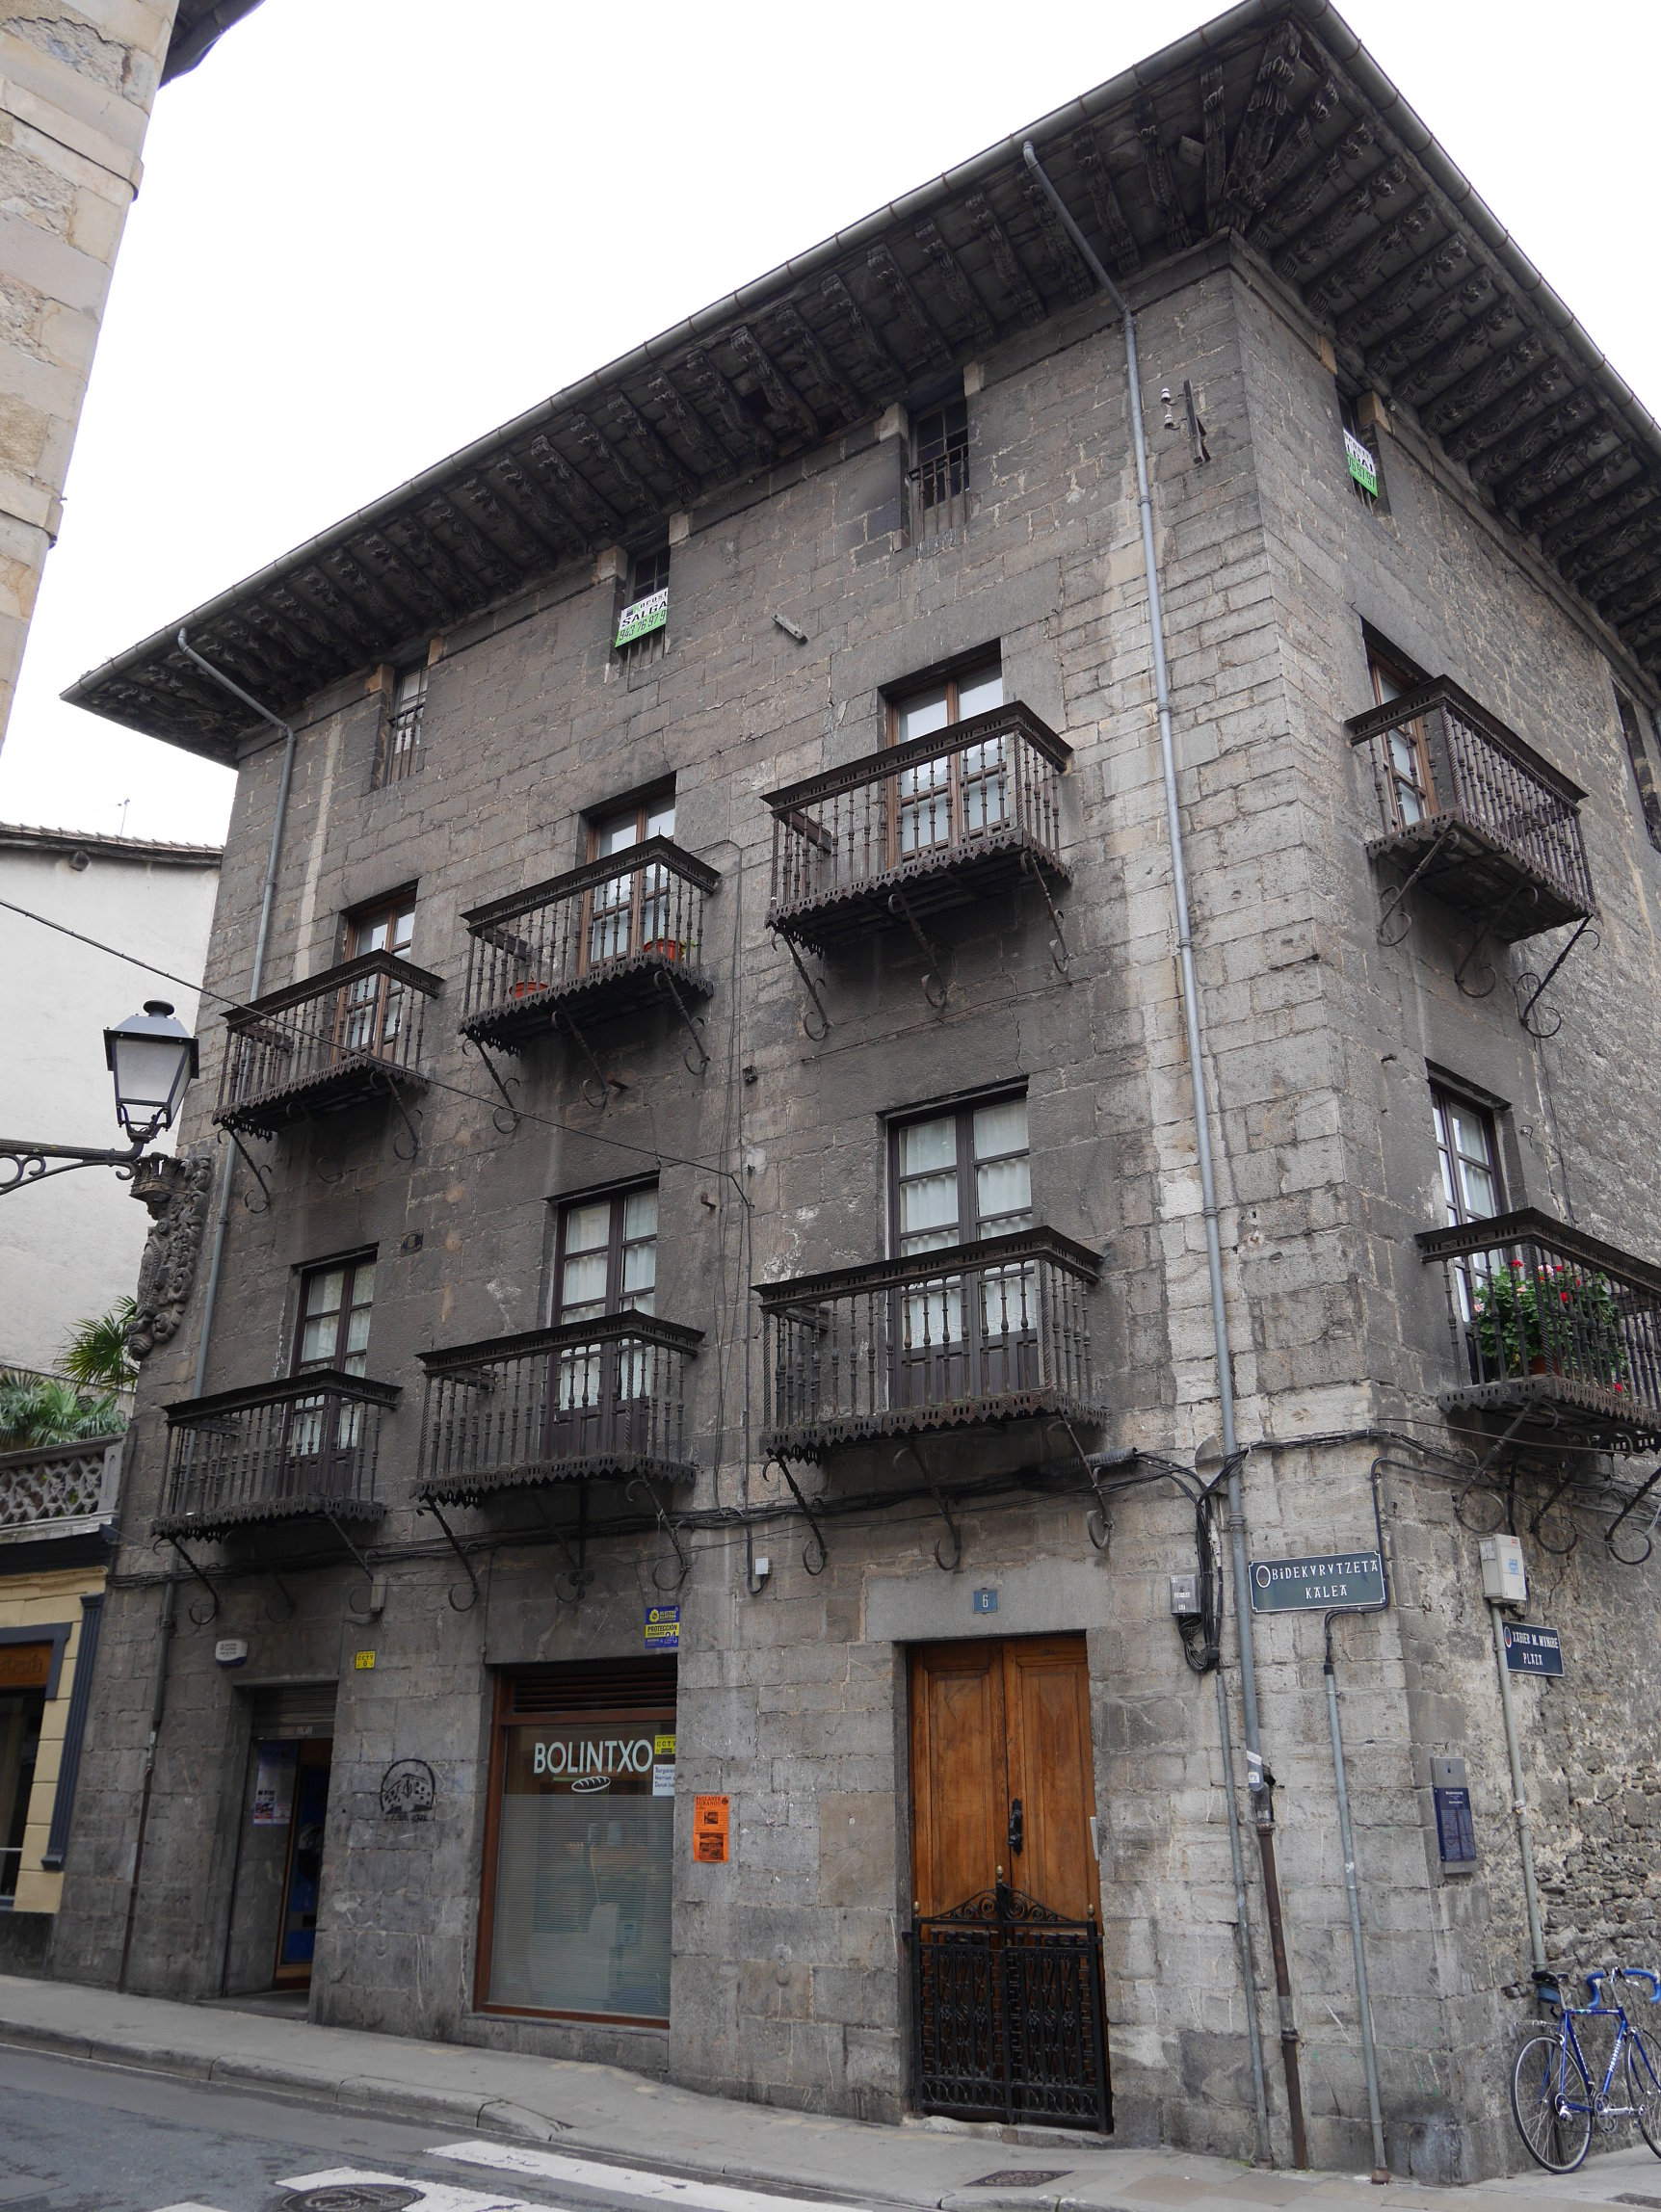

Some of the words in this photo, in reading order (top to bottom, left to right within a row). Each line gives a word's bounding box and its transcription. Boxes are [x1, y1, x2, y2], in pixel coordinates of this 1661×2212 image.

[619, 624, 636, 642] 943
[637, 619, 647, 633] 76
[1305, 1584, 1348, 1599] KALEA
[982, 1593, 989, 1608] 6
[1523, 1652, 1543, 1666] PLAZA
[533, 1739, 653, 1774] BOLINTXO
